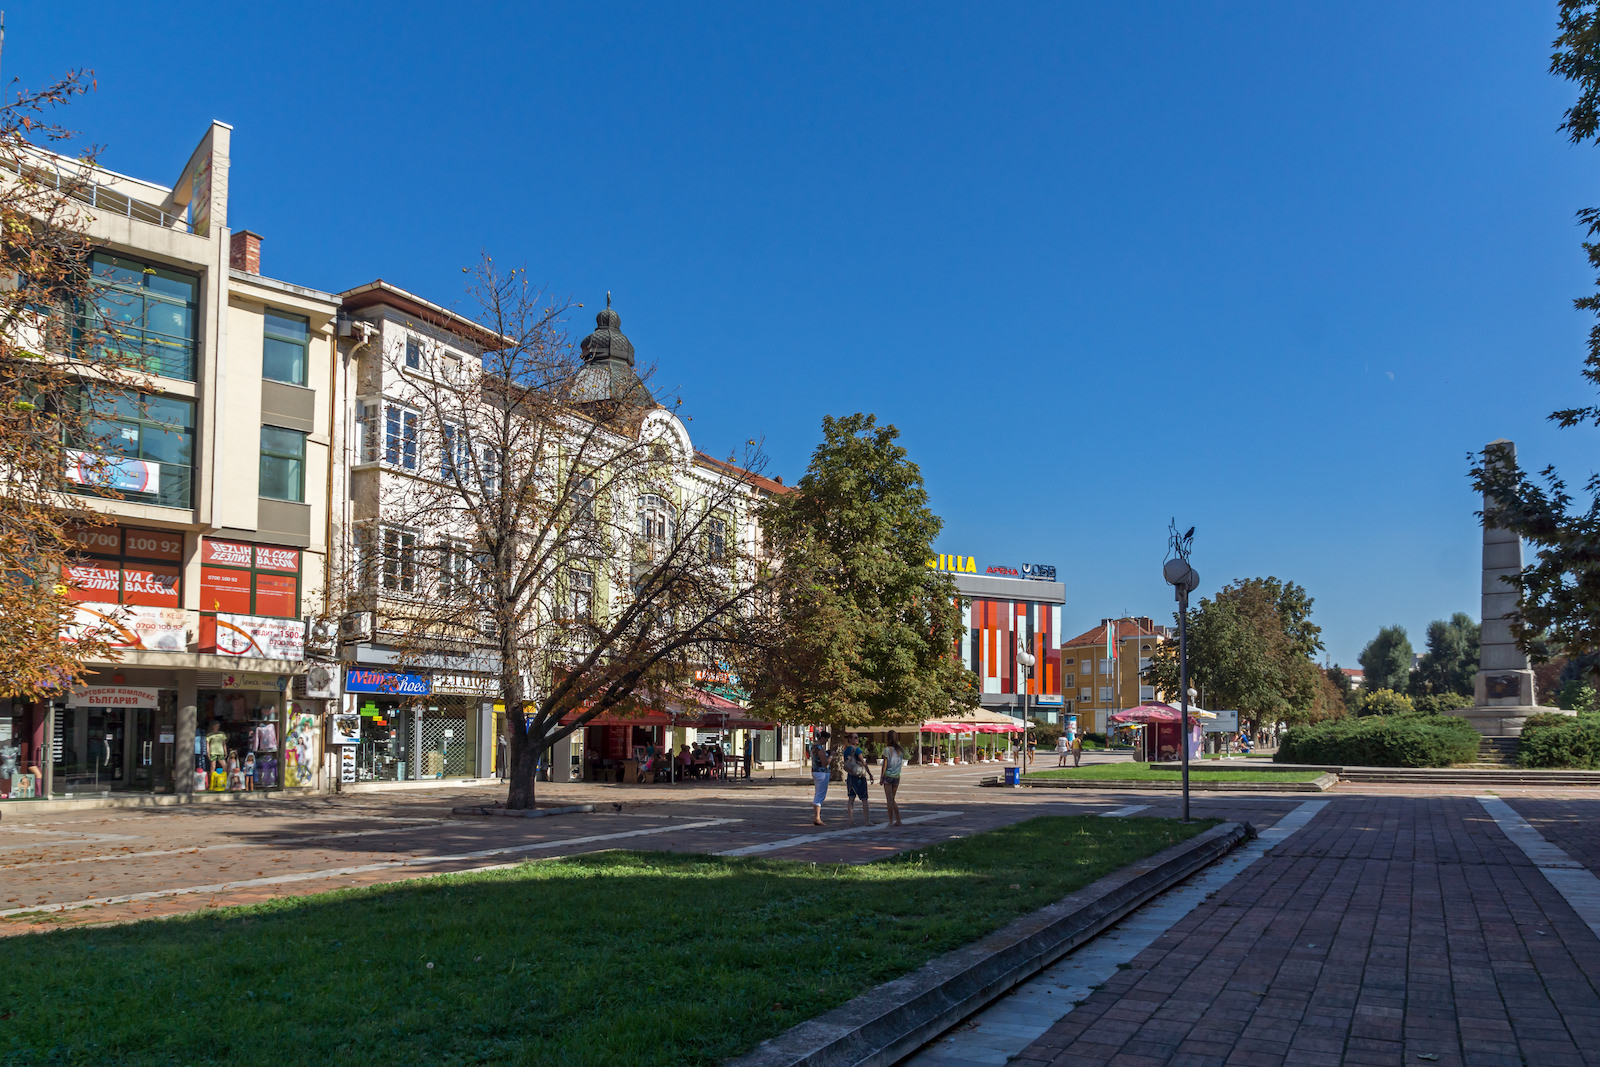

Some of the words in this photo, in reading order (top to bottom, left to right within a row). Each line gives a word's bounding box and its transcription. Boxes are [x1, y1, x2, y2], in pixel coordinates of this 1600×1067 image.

[77, 531, 118, 547] 0700
[128, 538, 157, 551] 100
[161, 541, 180, 553] 92
[136, 622, 156, 630] 0700
[280, 630, 299, 639] 1500
[75, 688, 115, 699] ТЪРГОВСКИ
[118, 689, 155, 700] КОМПЛЕКС
[89, 696, 138, 704] БЪЛГАРИЯ
